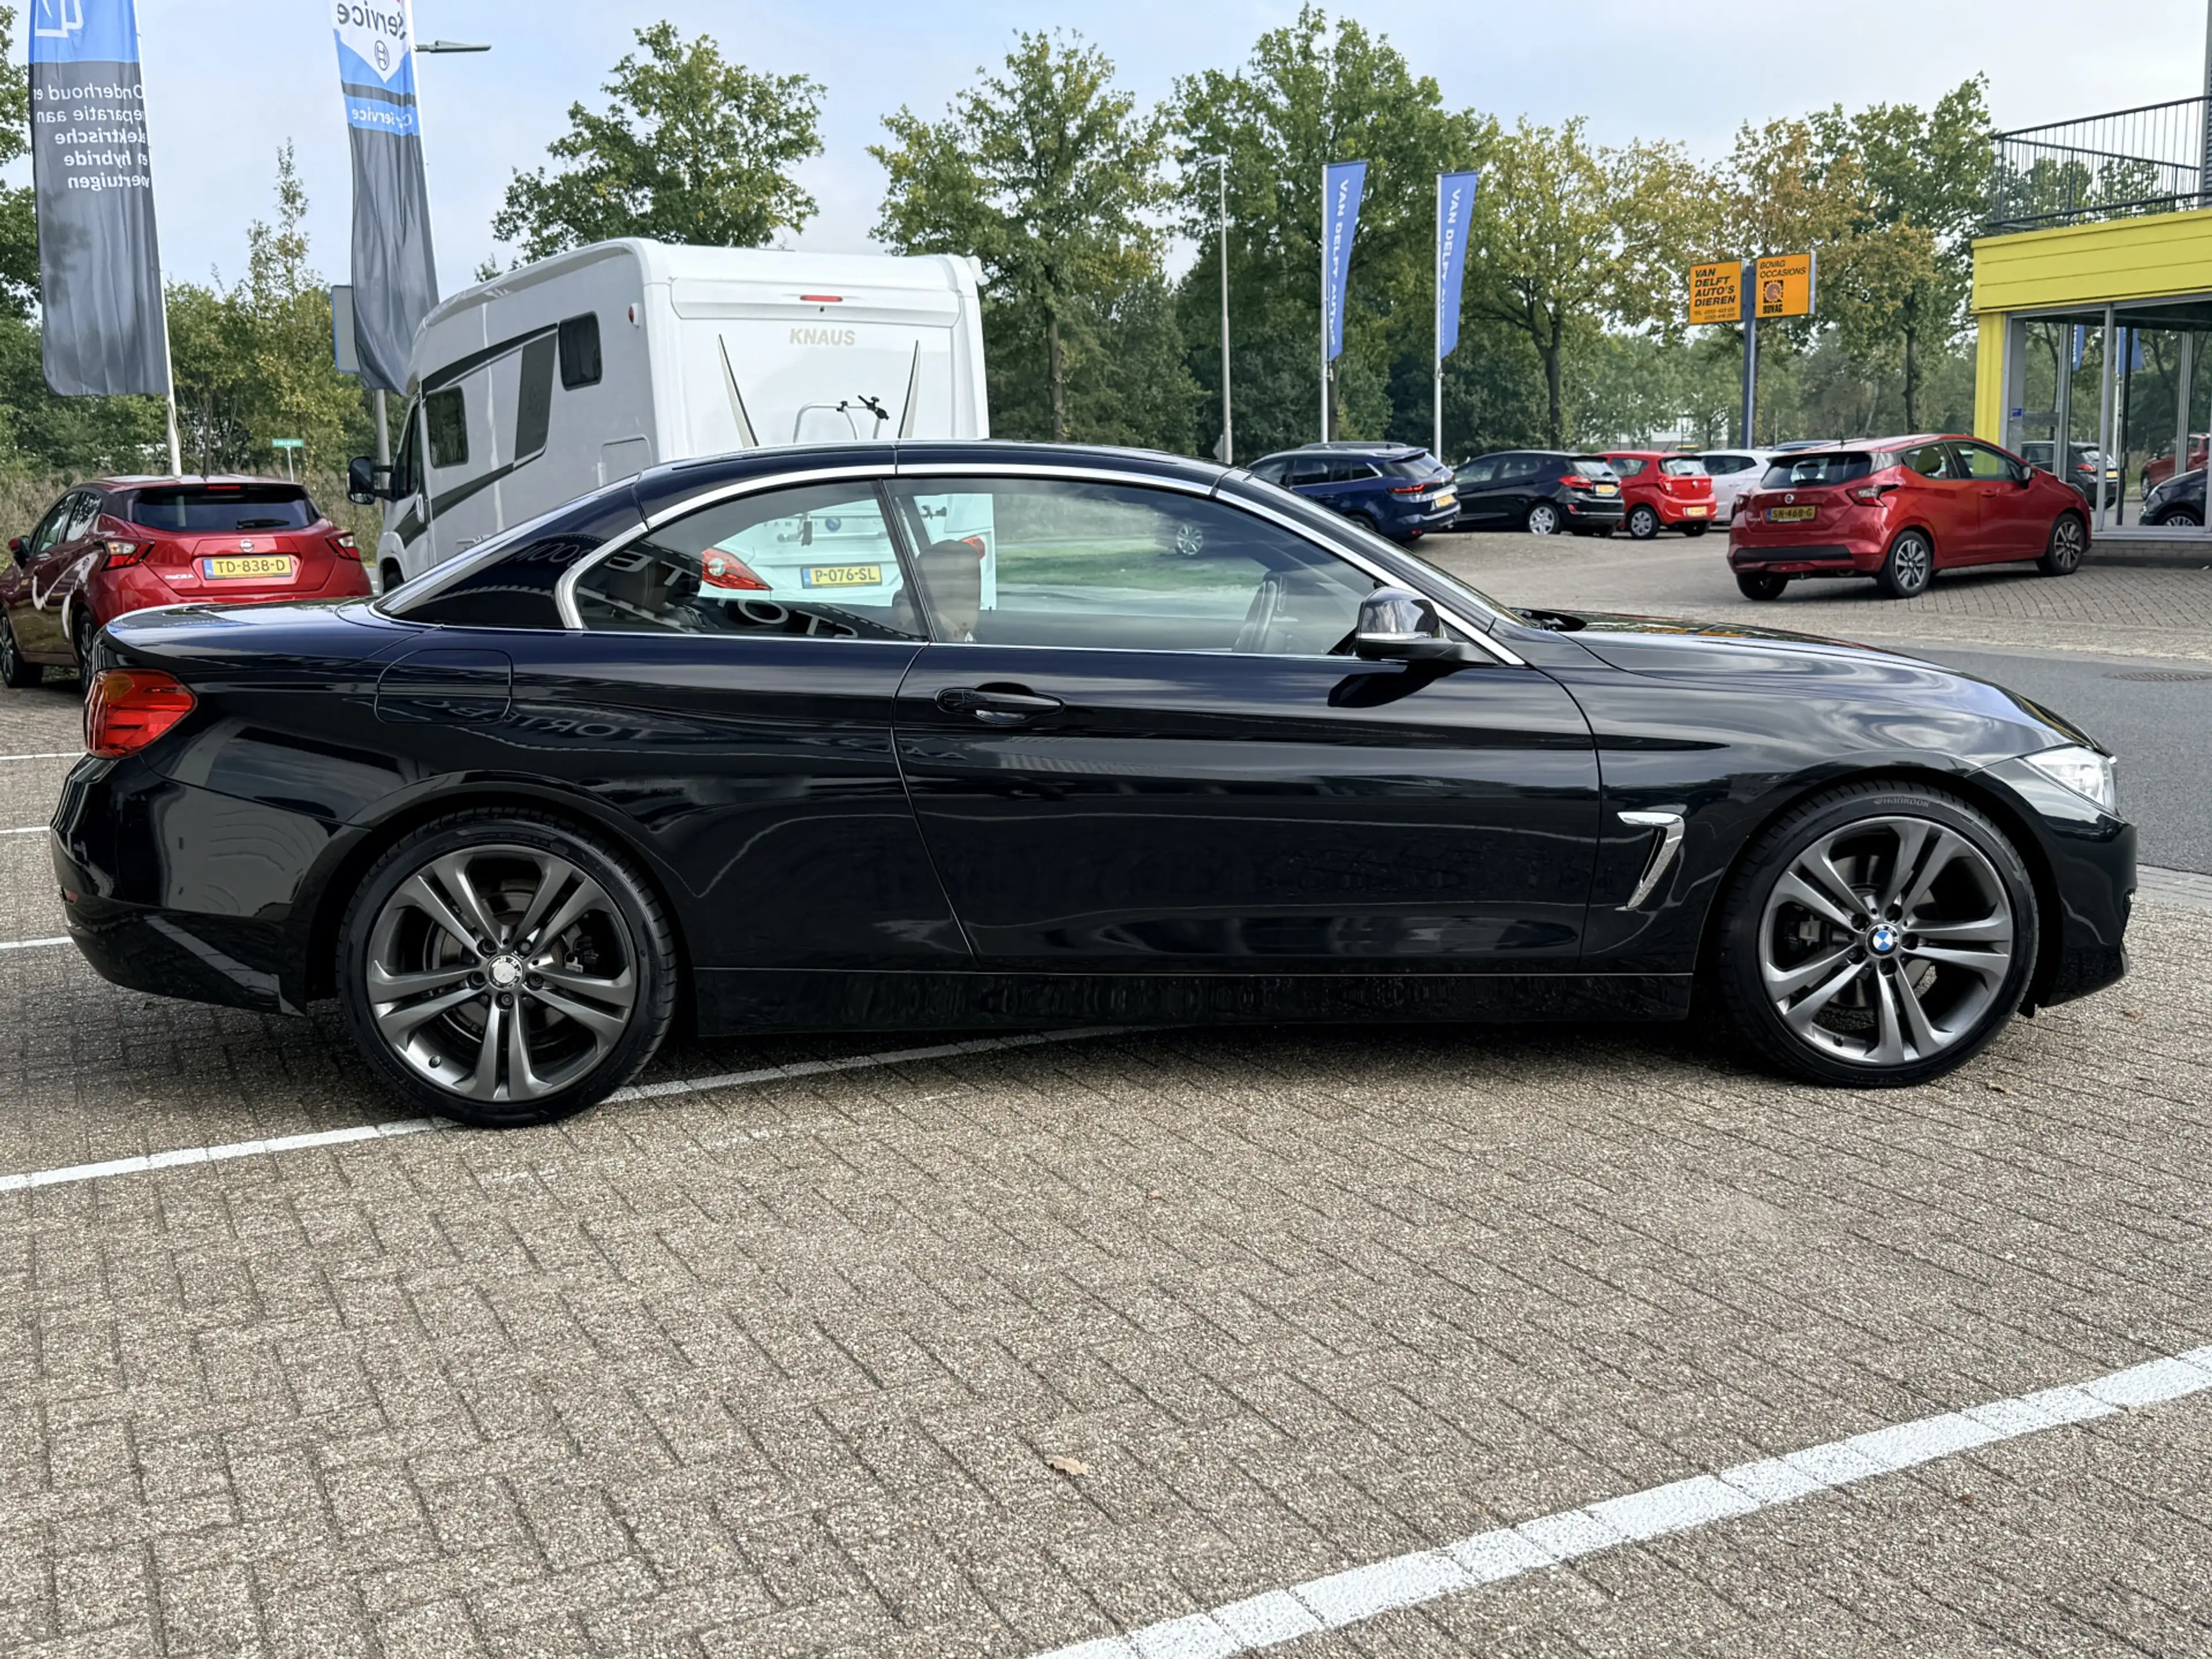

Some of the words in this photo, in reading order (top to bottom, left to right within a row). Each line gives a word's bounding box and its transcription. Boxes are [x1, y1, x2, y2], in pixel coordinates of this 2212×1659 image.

[1336, 178, 1349, 217] VAN
[1447, 188, 1461, 224] VAN
[1695, 268, 1716, 278] VAN
[1760, 267, 1806, 278] OCCASIONS
[1694, 276, 1731, 287] DELFT
[1694, 286, 1735, 297] AUTO'S
[1694, 296, 1736, 307] DIEREN
[789, 328, 856, 346] KNAUS
[216, 559, 286, 574] TD-838-D
[815, 568, 876, 582] P-076-SL
